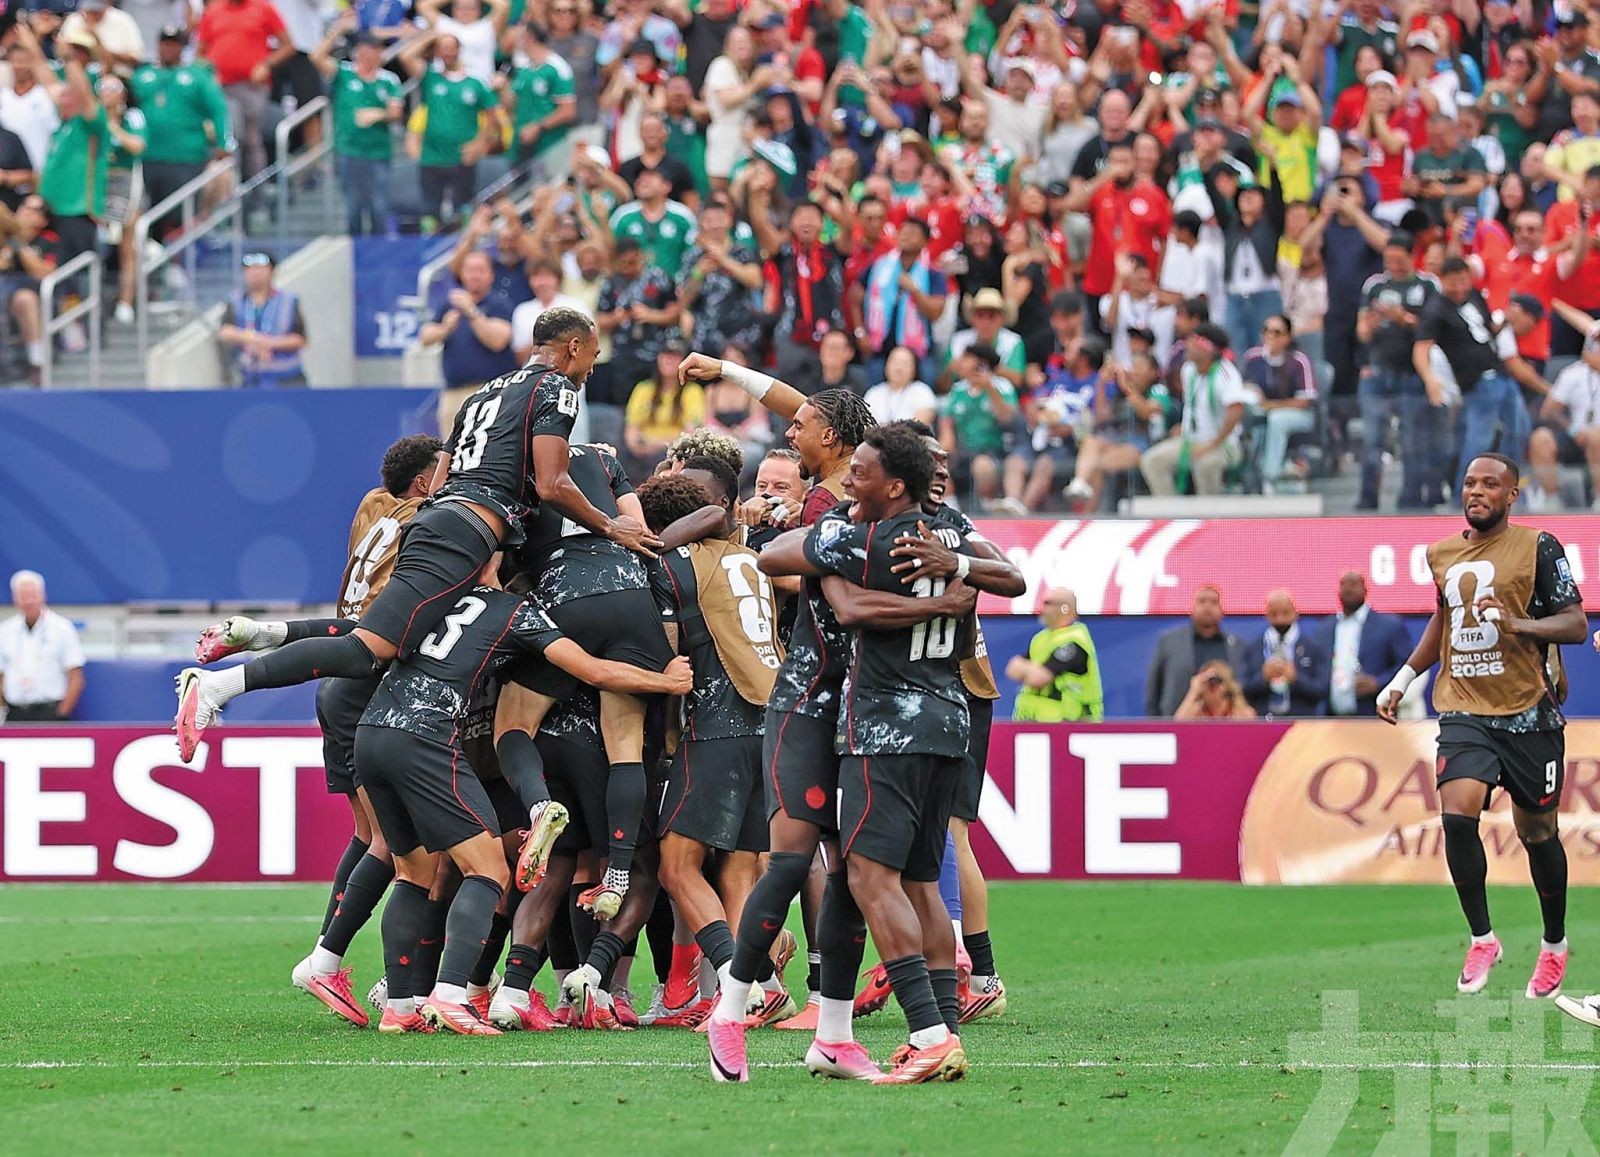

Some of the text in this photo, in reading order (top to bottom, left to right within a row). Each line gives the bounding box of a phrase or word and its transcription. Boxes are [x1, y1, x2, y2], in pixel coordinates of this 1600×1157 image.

[374, 310, 418, 349] 12
[451, 395, 502, 472] 13
[420, 595, 487, 661] 3
[1460, 632, 1484, 642] FIFA
[1451, 651, 1502, 663] WORLD CUP
[1451, 661, 1505, 678] 2026
[464, 721, 492, 740] 202
[1306, 756, 1600, 826] QAR
[1545, 760, 1556, 794] 9
